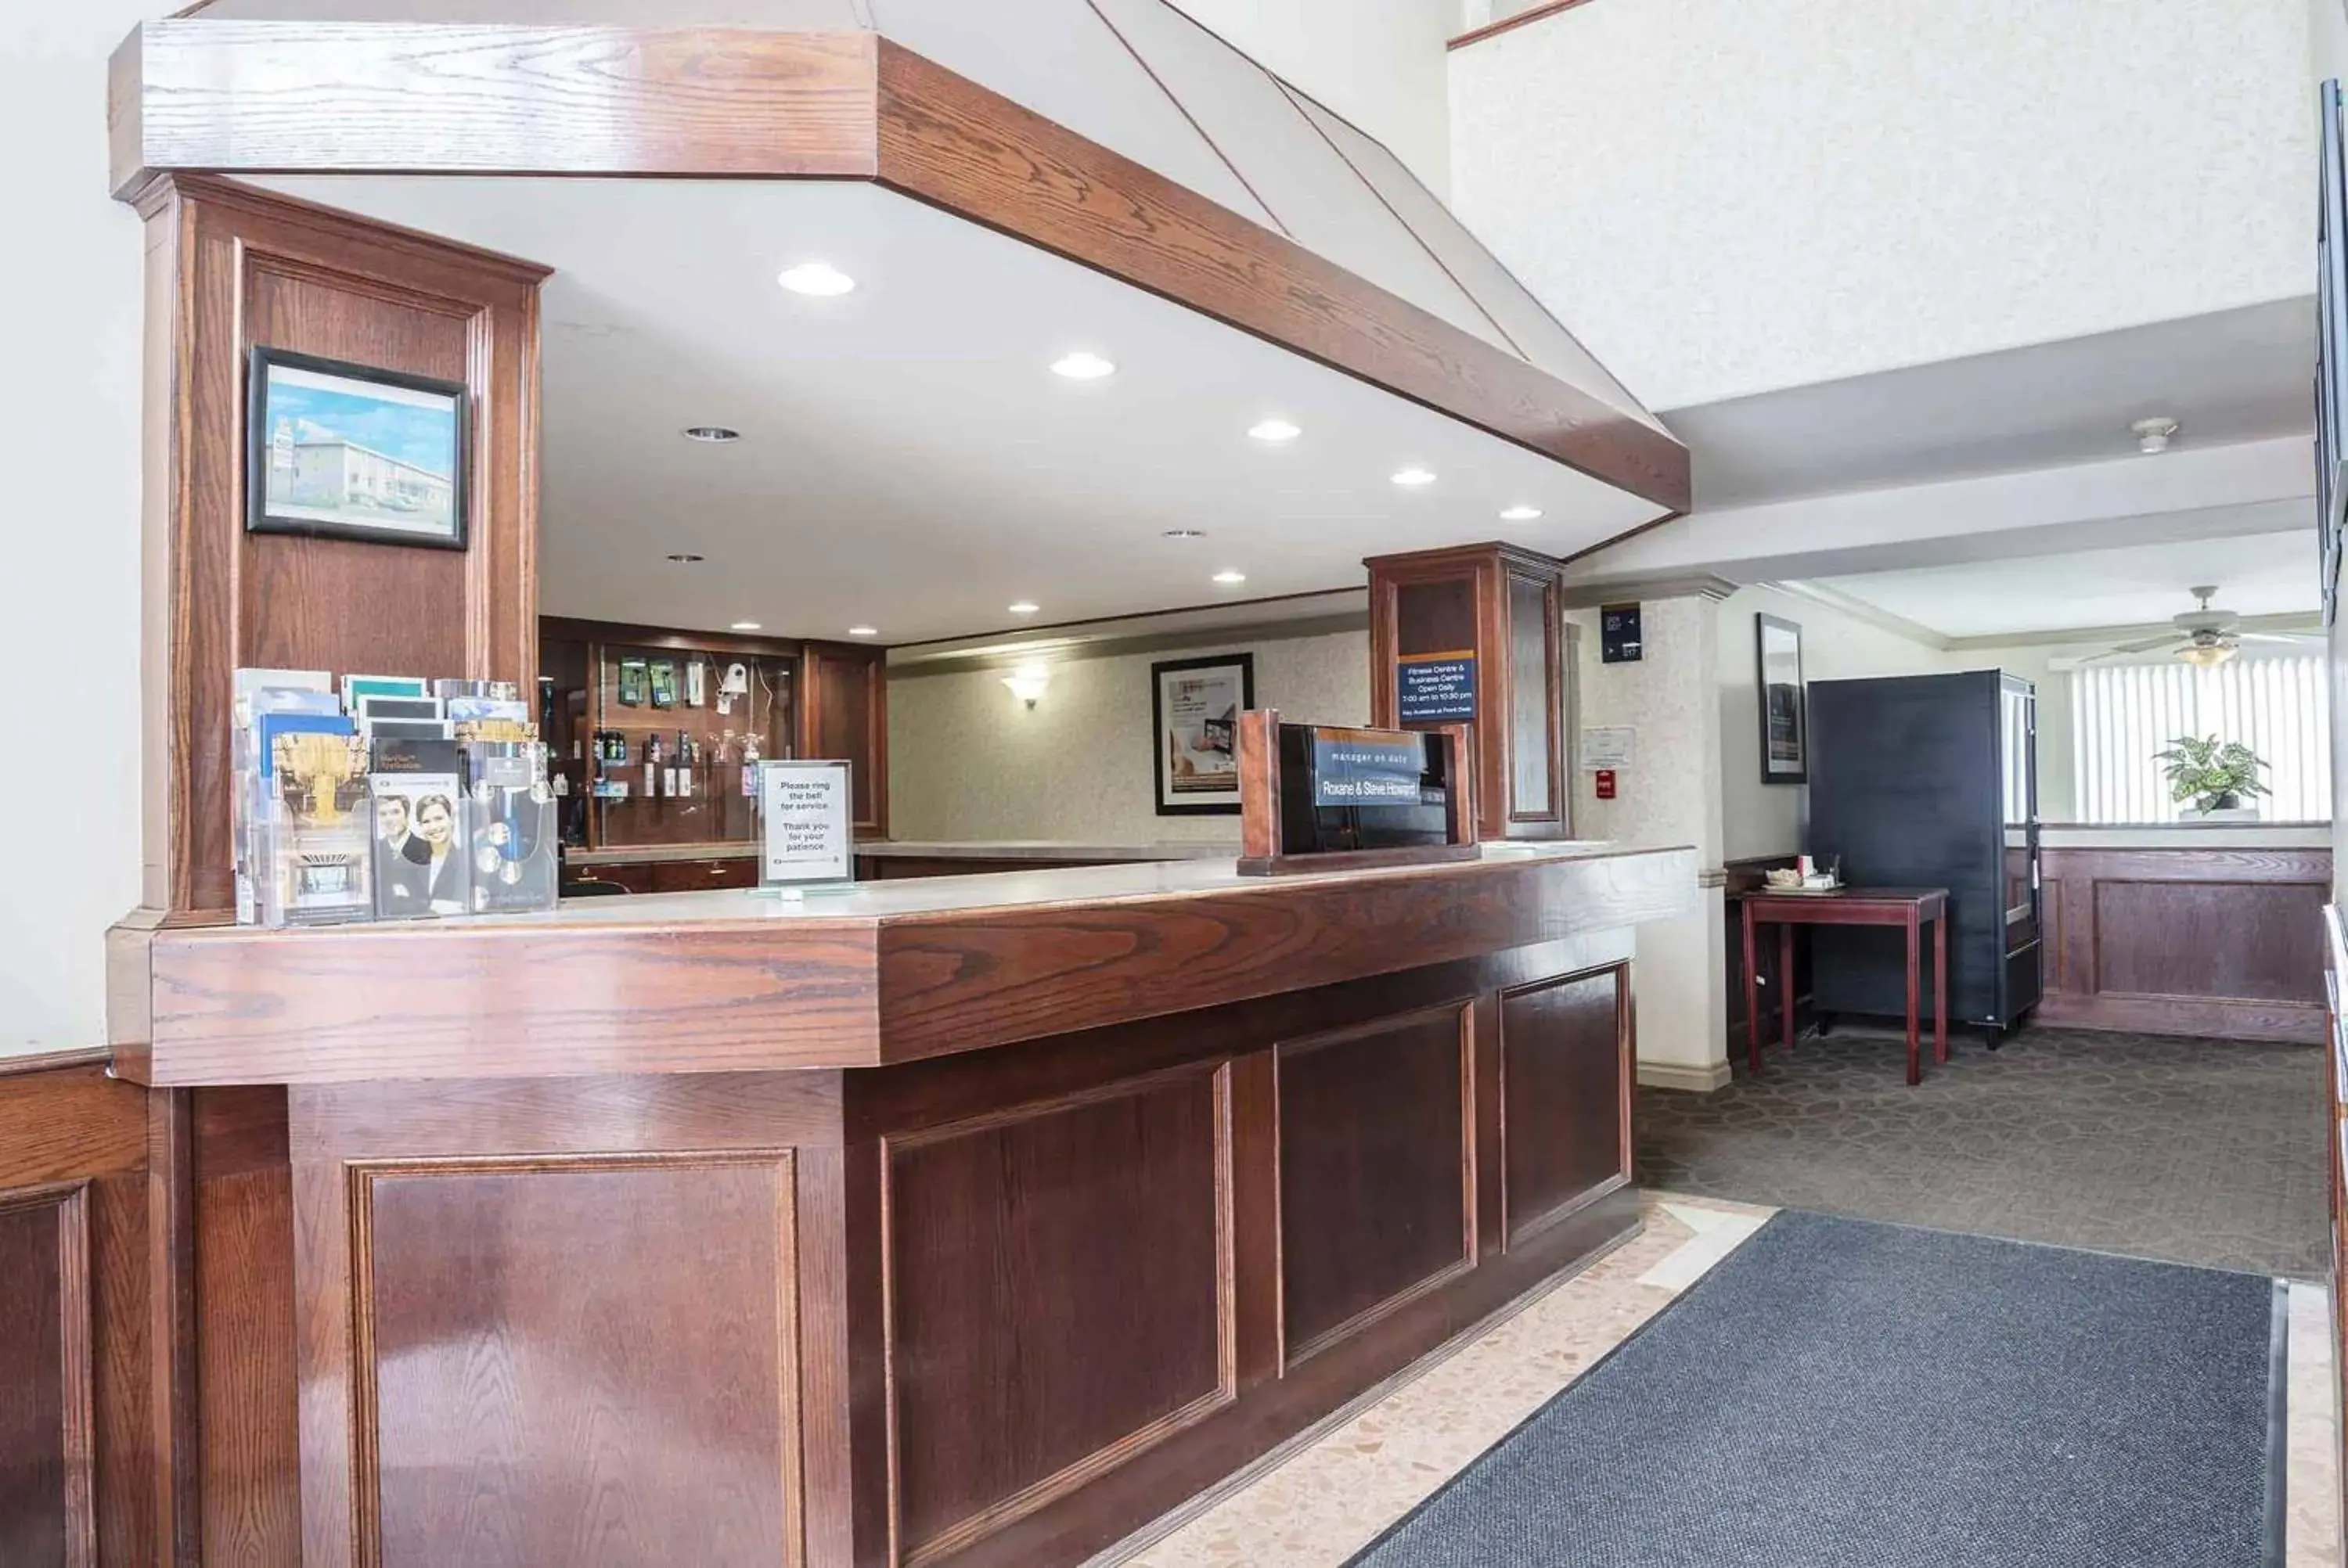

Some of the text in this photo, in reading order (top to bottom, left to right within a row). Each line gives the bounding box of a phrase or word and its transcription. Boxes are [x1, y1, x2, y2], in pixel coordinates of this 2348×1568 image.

[1408, 676, 1439, 685] Business
[1460, 692, 1472, 700] pm
[1331, 752, 1408, 764] manager on duty
[812, 782, 830, 791] ring
[1323, 781, 1417, 797] Roxane & Steve Howard
[783, 822, 811, 830] Thank
[789, 832, 825, 842] for your
